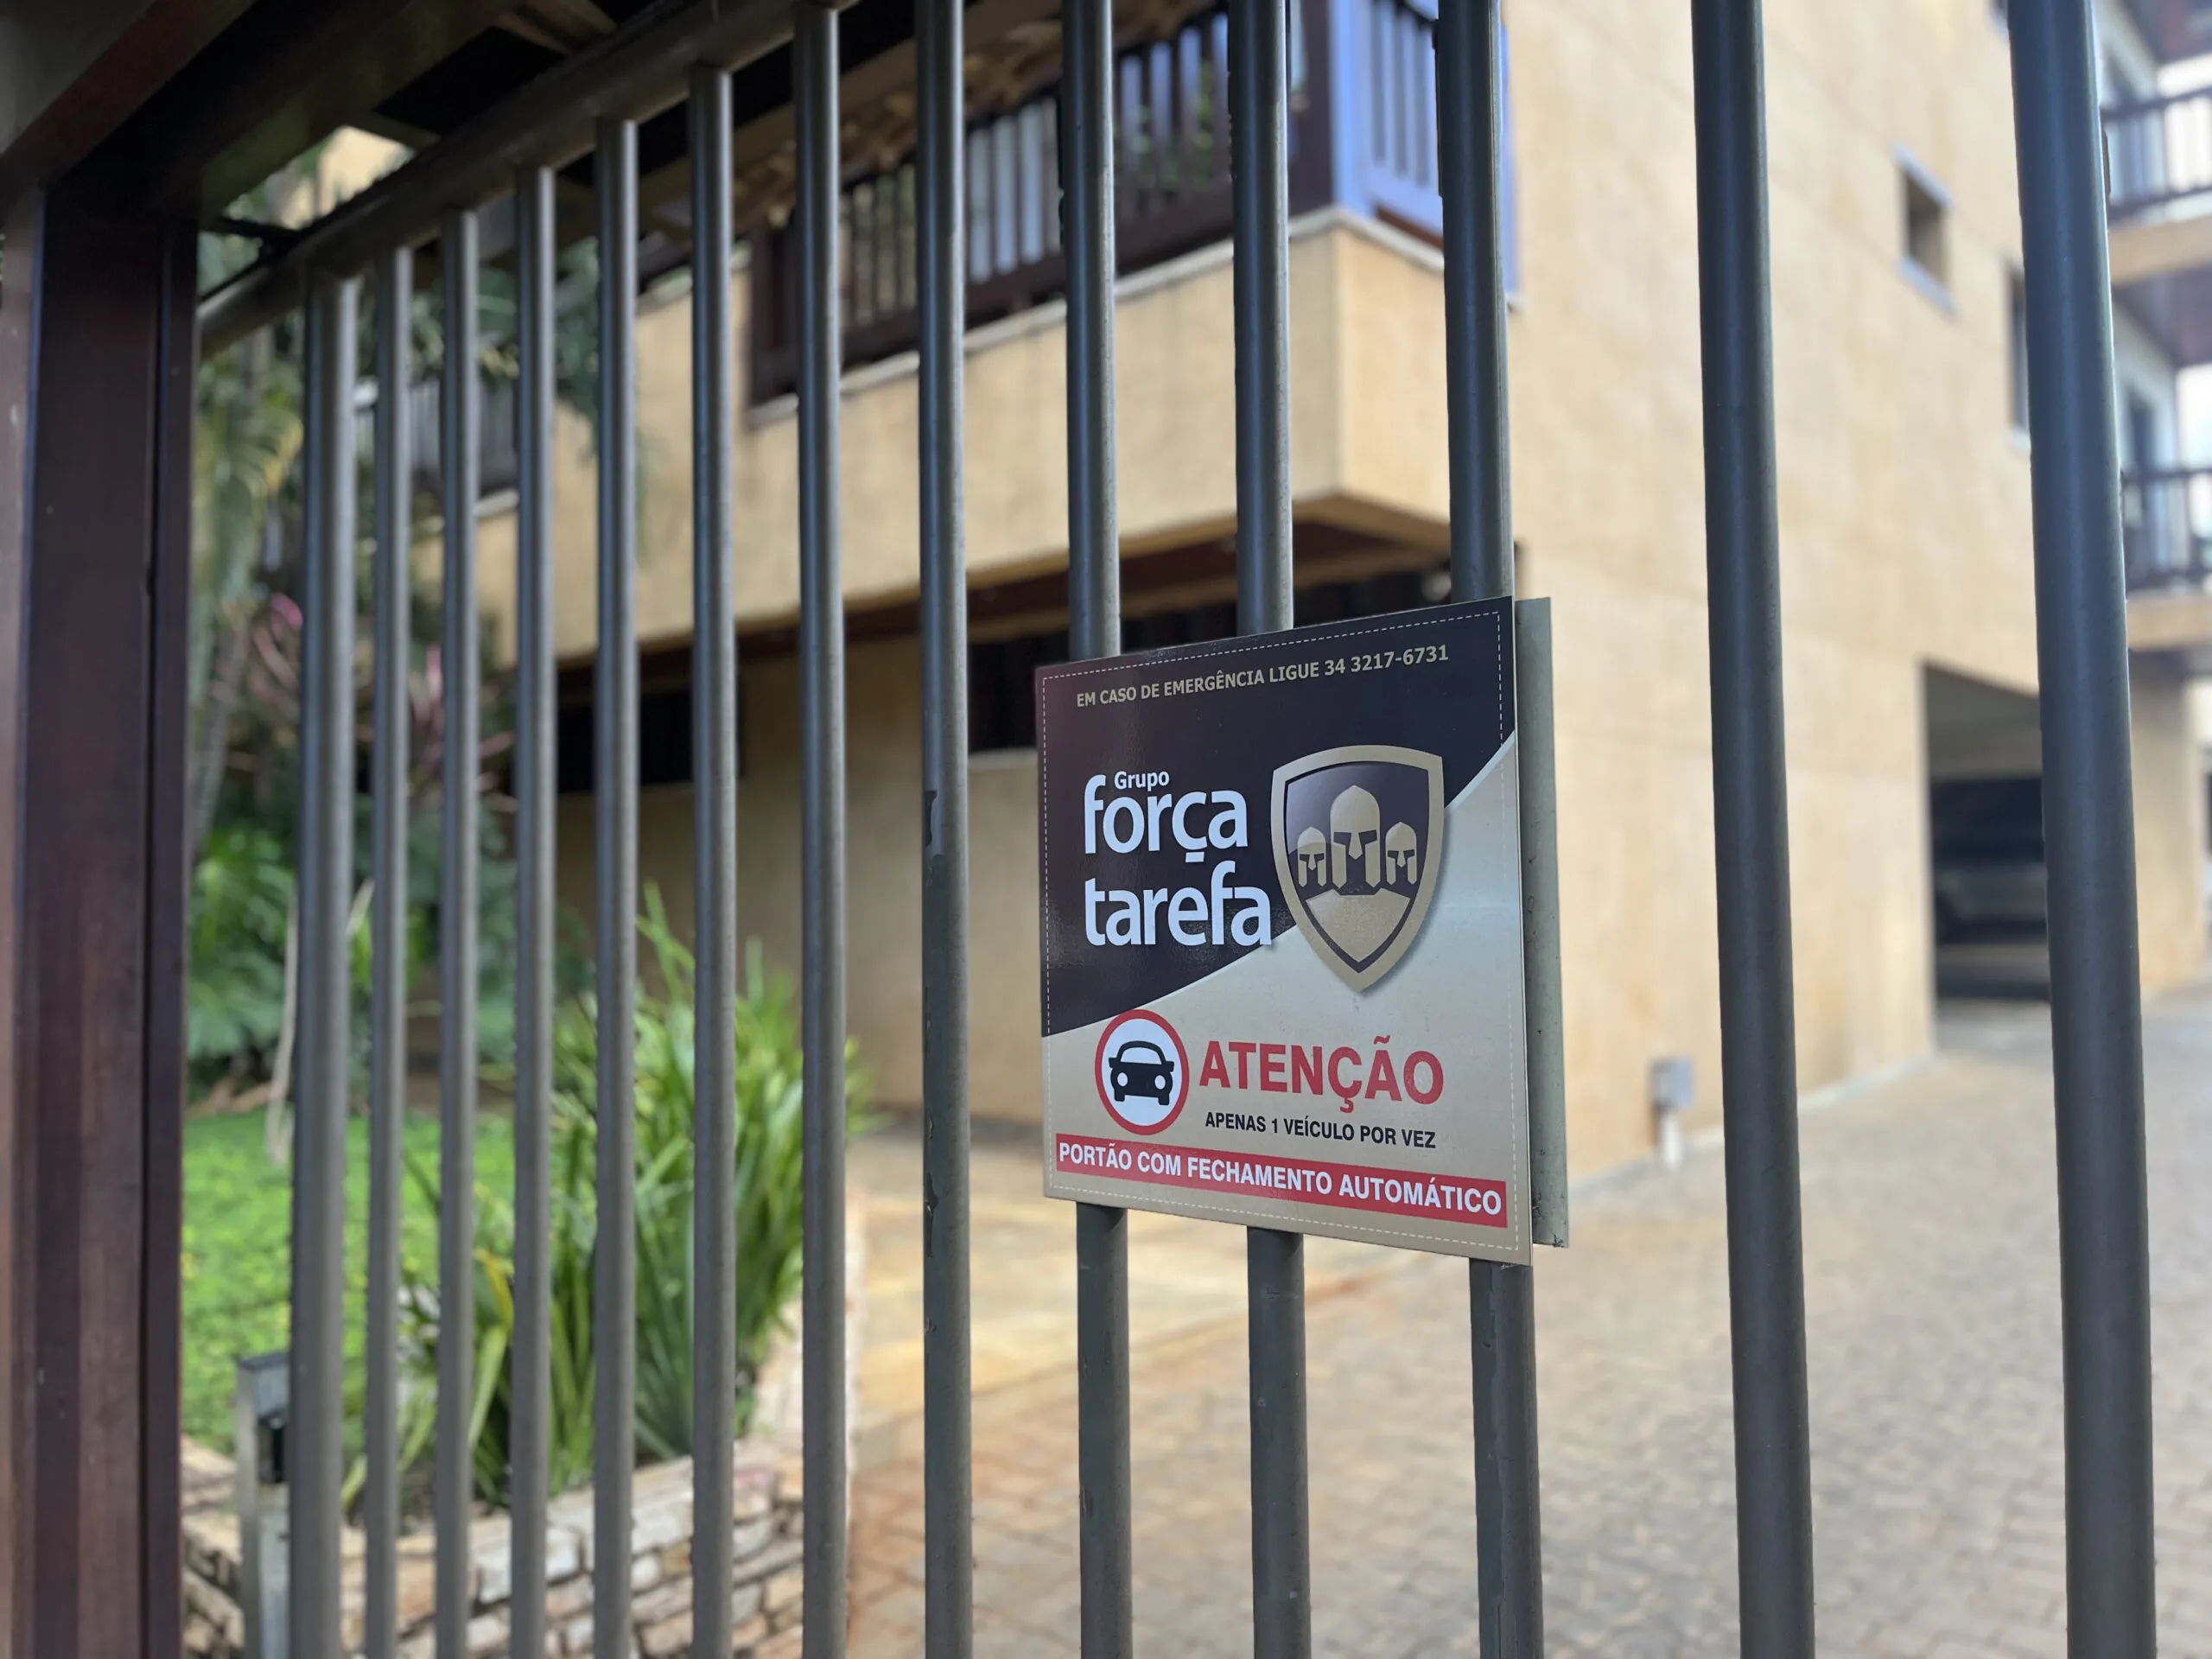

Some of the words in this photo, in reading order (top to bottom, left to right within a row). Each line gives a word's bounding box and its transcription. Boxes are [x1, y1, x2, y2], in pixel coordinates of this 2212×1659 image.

[1077, 693, 1096, 708] EM
[1099, 687, 1137, 704] CASO
[1141, 683, 1160, 699] DE
[1165, 670, 1265, 696] EMERGÊNCIA
[1269, 662, 1319, 683] LIGUE
[1325, 659, 1346, 676] 34
[1351, 645, 1449, 672] 3217-6731
[1084, 774, 1249, 863] força
[1114, 771, 1170, 791] Grupo
[1084, 860, 1272, 947] tarefa
[1199, 1035, 1444, 1114] ATENÇÃO
[1205, 1111, 1267, 1134] APENAS
[1272, 1118, 1279, 1134] 1
[1284, 1116, 1355, 1141] VEÍCULO
[1360, 1126, 1396, 1146] POR
[1402, 1129, 1437, 1149] VEZ
[1059, 1141, 1133, 1171] PORTÃO
[1137, 1151, 1181, 1176] COM
[1187, 1158, 1332, 1195] FECHAMENTO
[1338, 1175, 1502, 1217] AUTOMÁTICO
